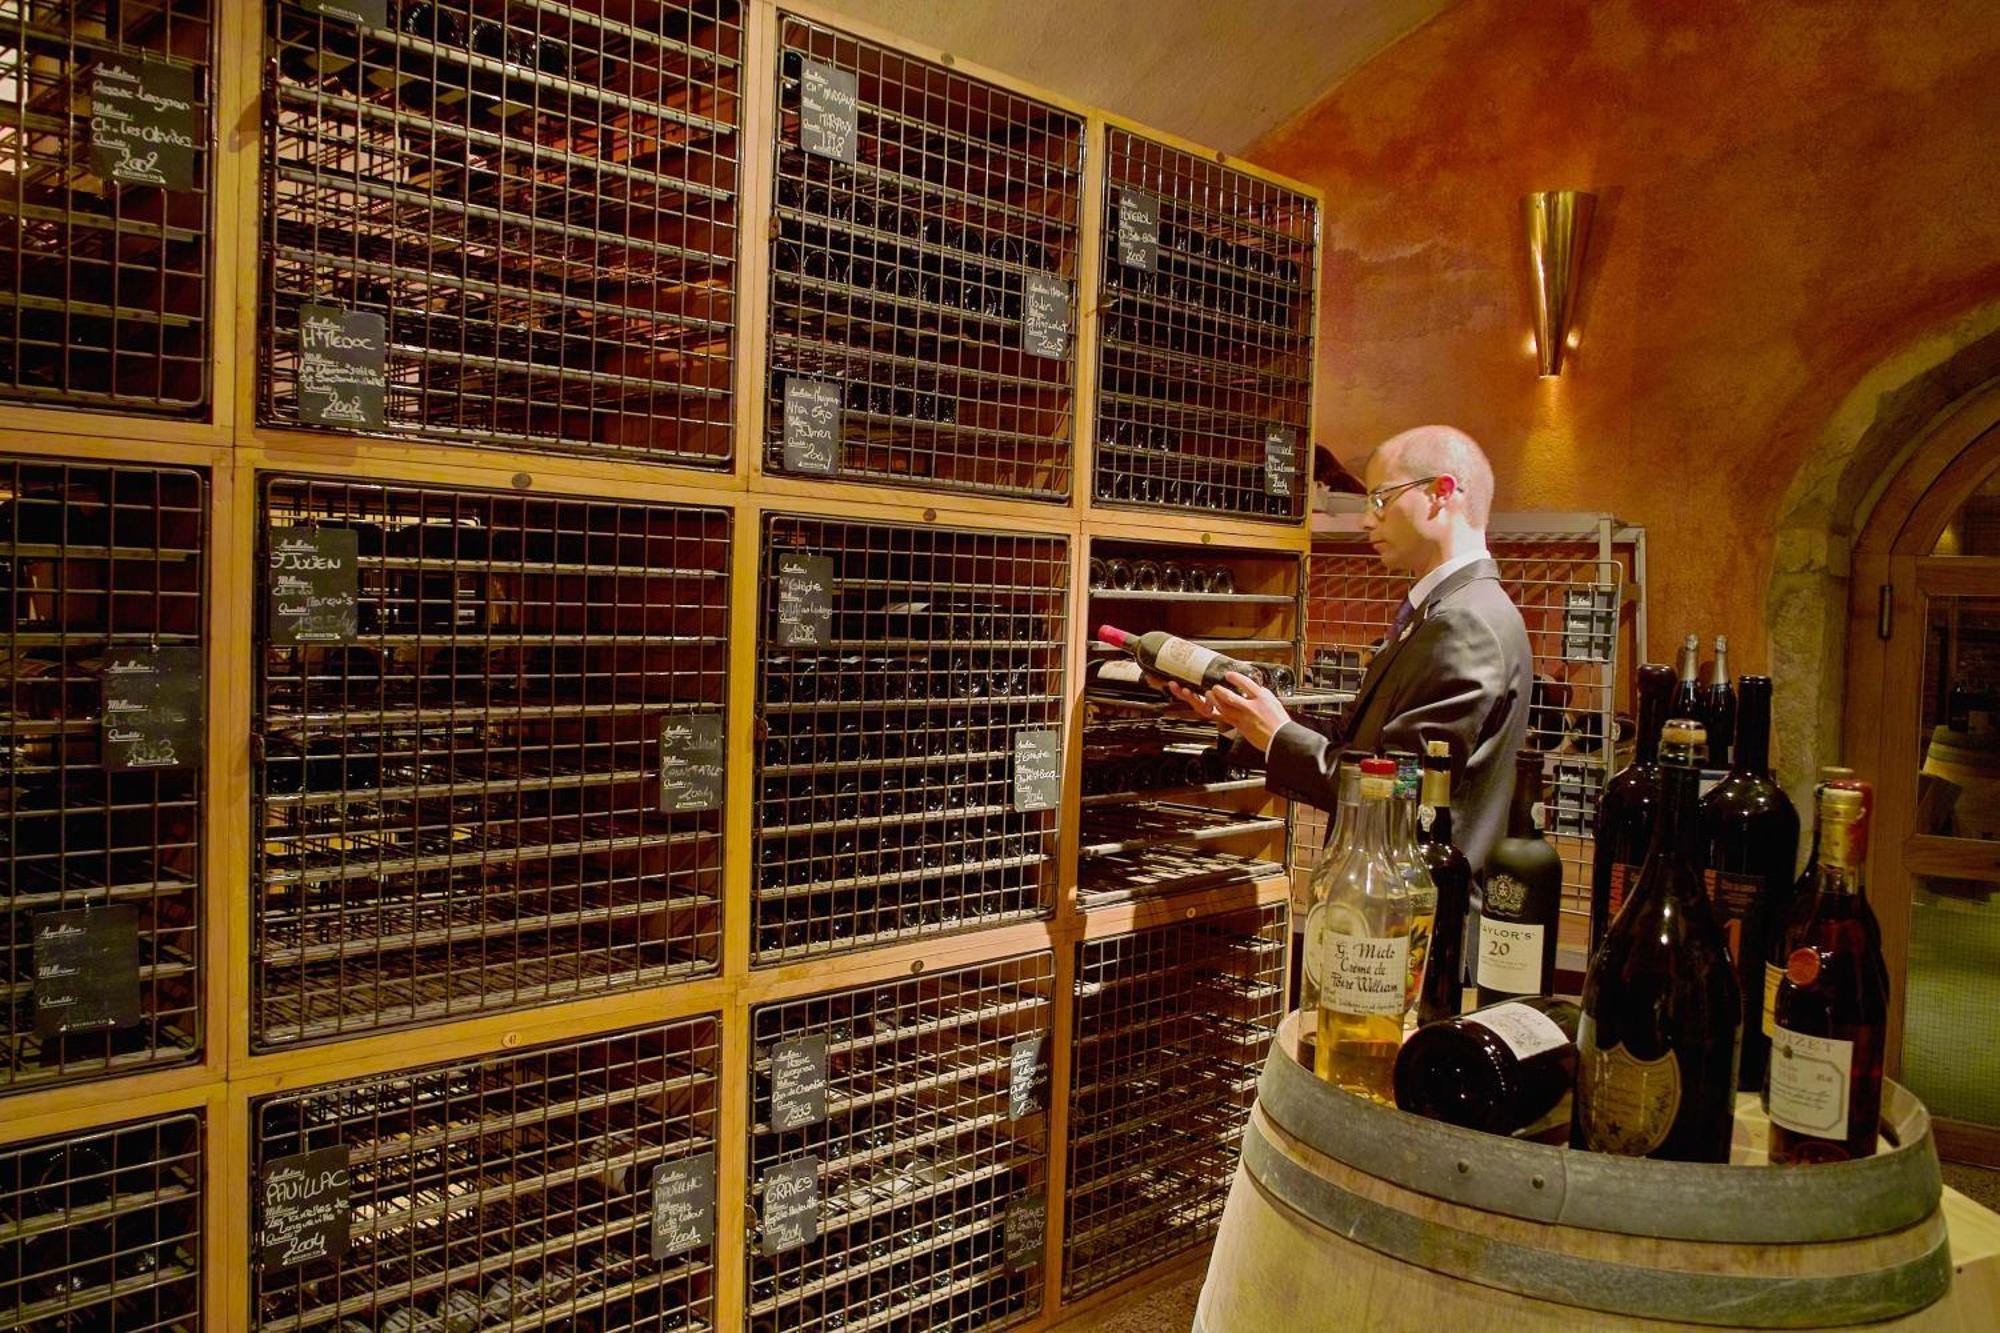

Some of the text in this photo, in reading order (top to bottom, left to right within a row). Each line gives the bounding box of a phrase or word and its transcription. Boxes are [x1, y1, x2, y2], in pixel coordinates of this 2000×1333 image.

[322, 391, 364, 414] 2002
[1488, 941, 1511, 956] 20
[766, 1177, 813, 1203] GRAVES
[282, 1232, 326, 1258] 2004
